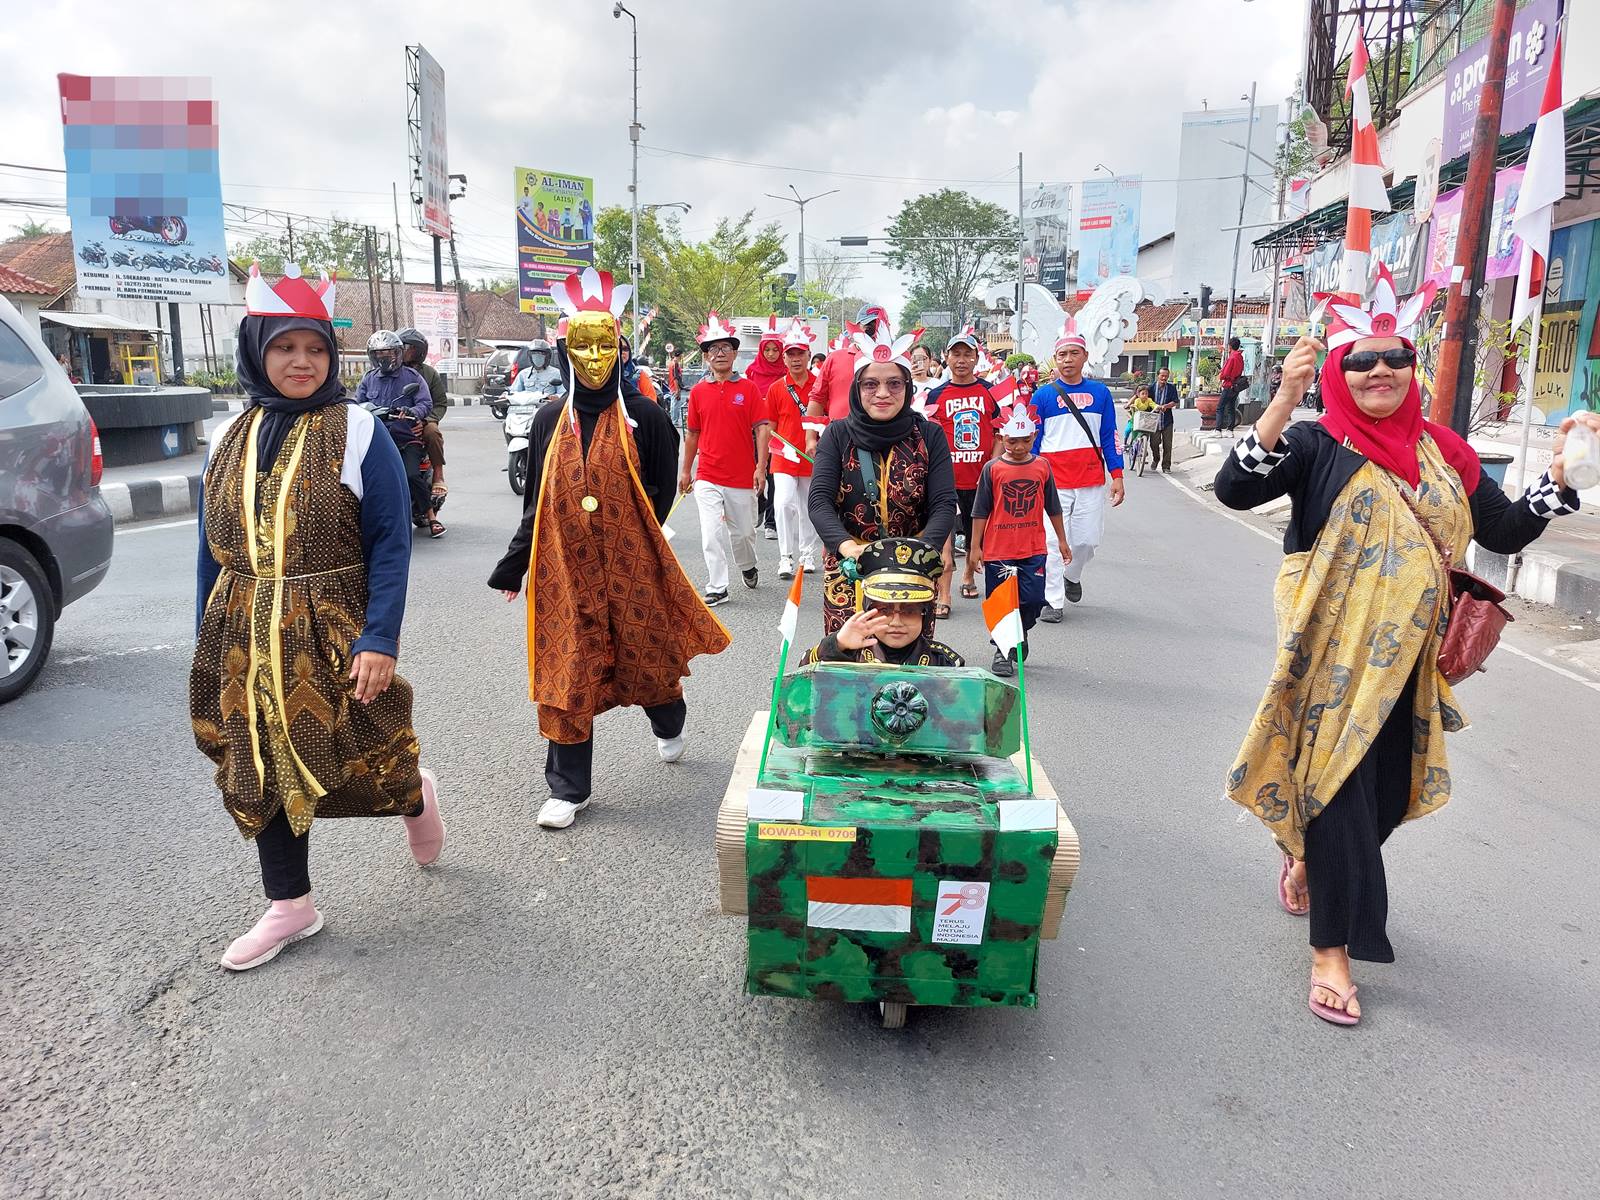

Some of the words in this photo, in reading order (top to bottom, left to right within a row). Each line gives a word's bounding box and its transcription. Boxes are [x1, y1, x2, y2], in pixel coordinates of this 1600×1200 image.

[1463, 31, 1522, 98] pron
[541, 176, 584, 191] AL-IMAN
[111, 233, 144, 242] MAXI
[1024, 262, 1038, 275] 200
[536, 304, 554, 312] CONTACT
[1374, 318, 1390, 333] 78
[875, 350, 888, 360] 78
[945, 396, 986, 418] OSAKA
[953, 409, 981, 451] 6
[1015, 421, 1026, 430] 78
[951, 451, 984, 463] SPORT
[759, 826, 821, 838] KOWAD-RI
[828, 830, 856, 839] 0709
[940, 883, 987, 916] 78
